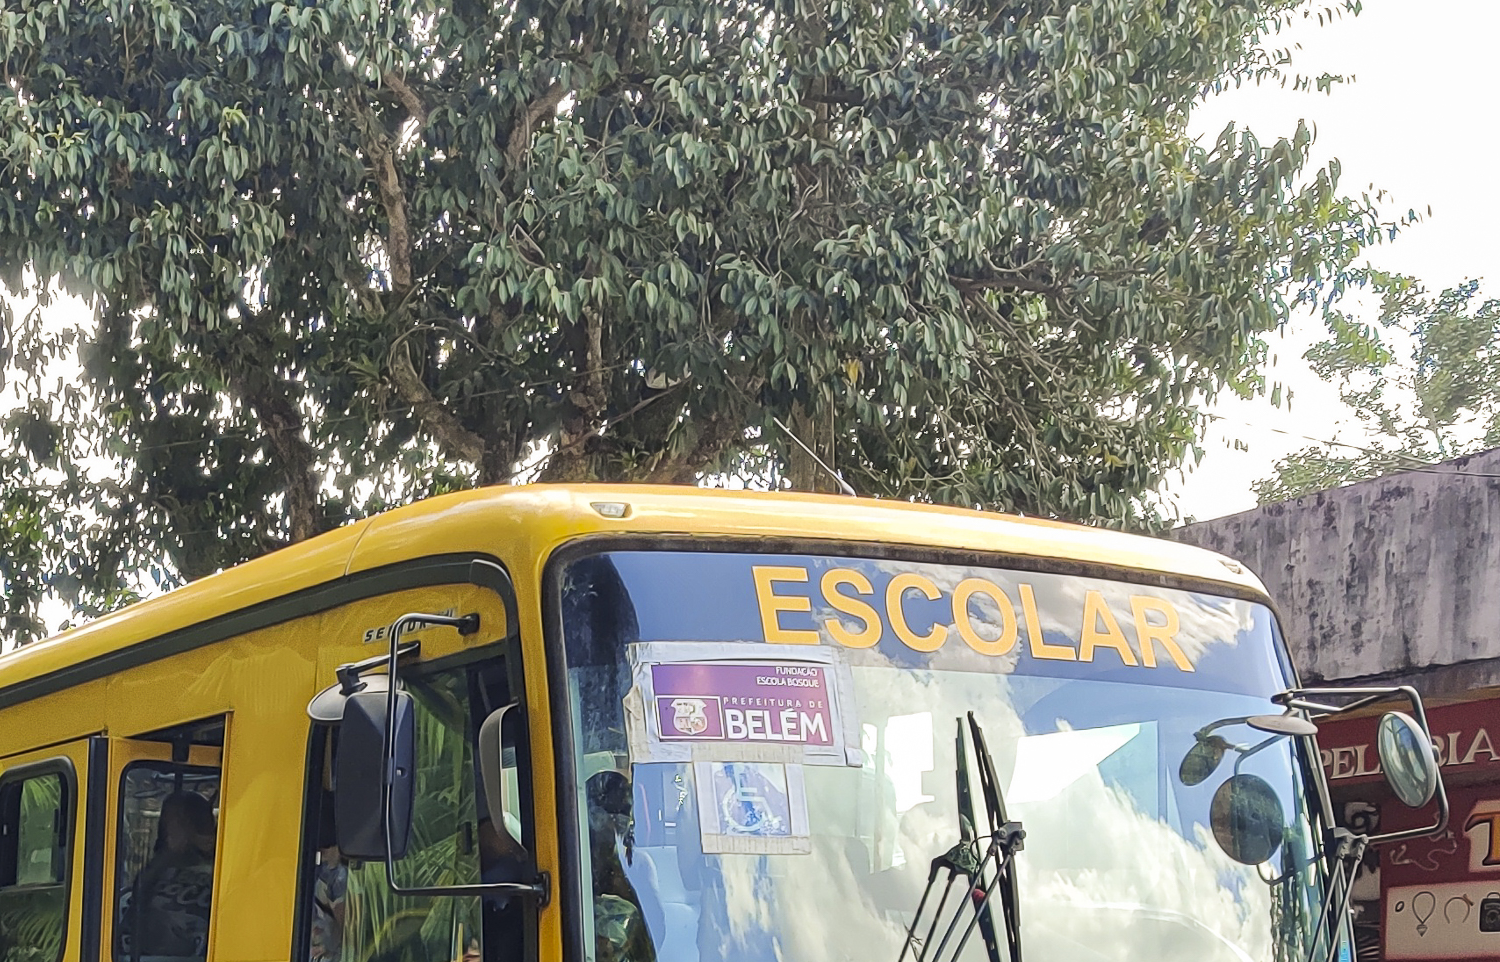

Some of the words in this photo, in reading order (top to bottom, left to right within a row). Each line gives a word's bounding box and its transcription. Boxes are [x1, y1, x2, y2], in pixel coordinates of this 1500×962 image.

[752, 565, 1196, 673] ESCOLAR
[756, 676, 787, 686] ESCOLA
[787, 677, 820, 688] BOSQUE
[723, 696, 802, 708] PREFEITURA
[808, 700, 824, 709] DE
[725, 707, 828, 742] BELÉM
